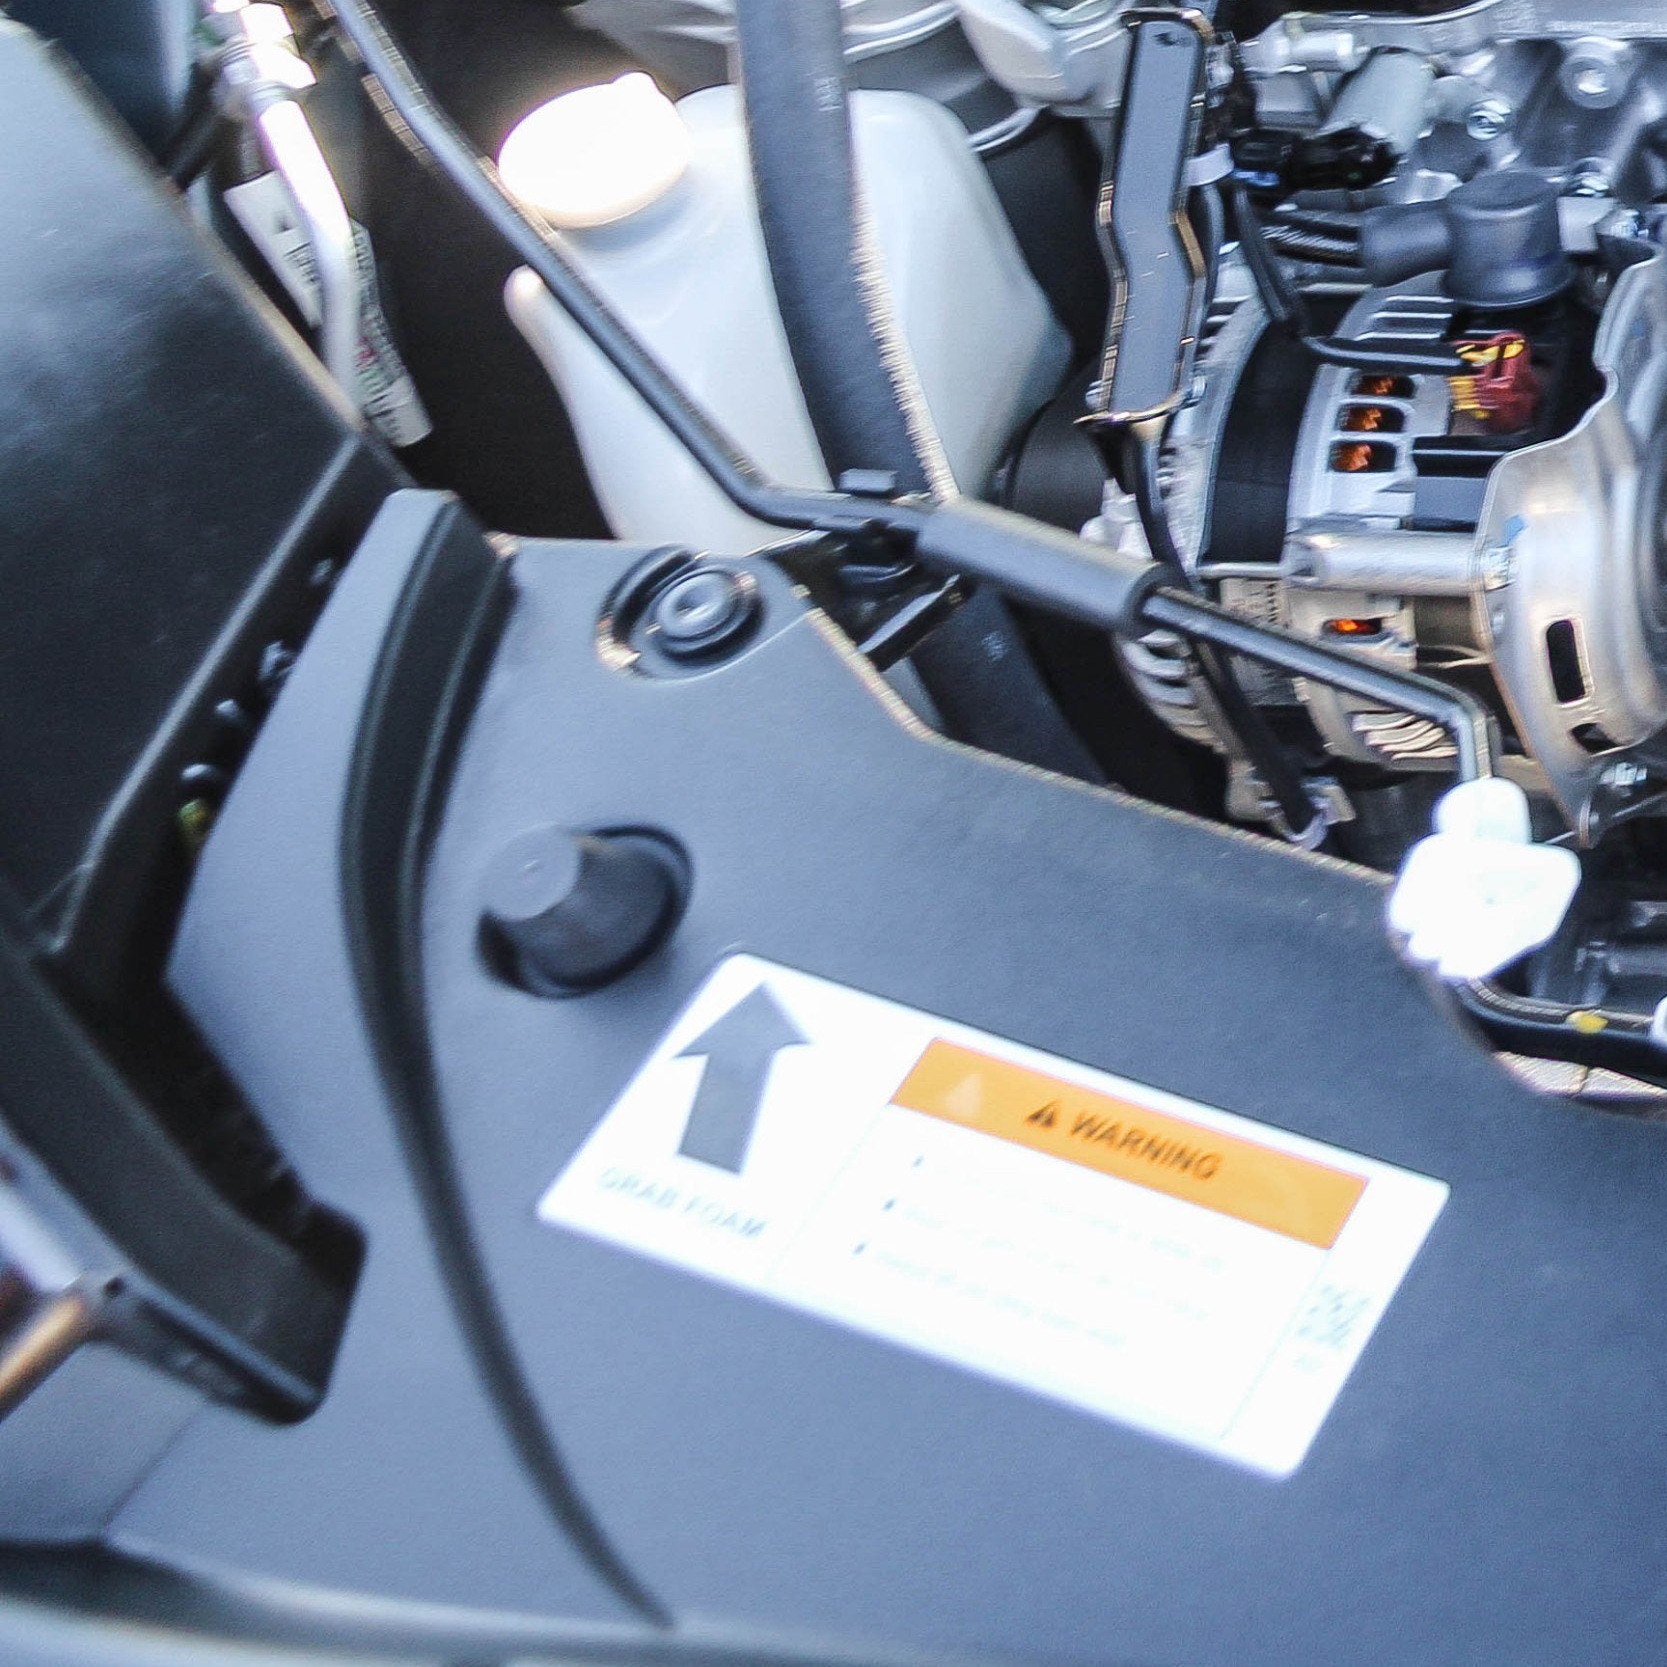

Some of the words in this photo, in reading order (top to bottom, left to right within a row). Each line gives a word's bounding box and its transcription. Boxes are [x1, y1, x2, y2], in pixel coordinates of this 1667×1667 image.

[1070, 1110, 1222, 1180] WARNING
[597, 1167, 680, 1209] GRAB
[682, 1195, 771, 1239] FOAM
